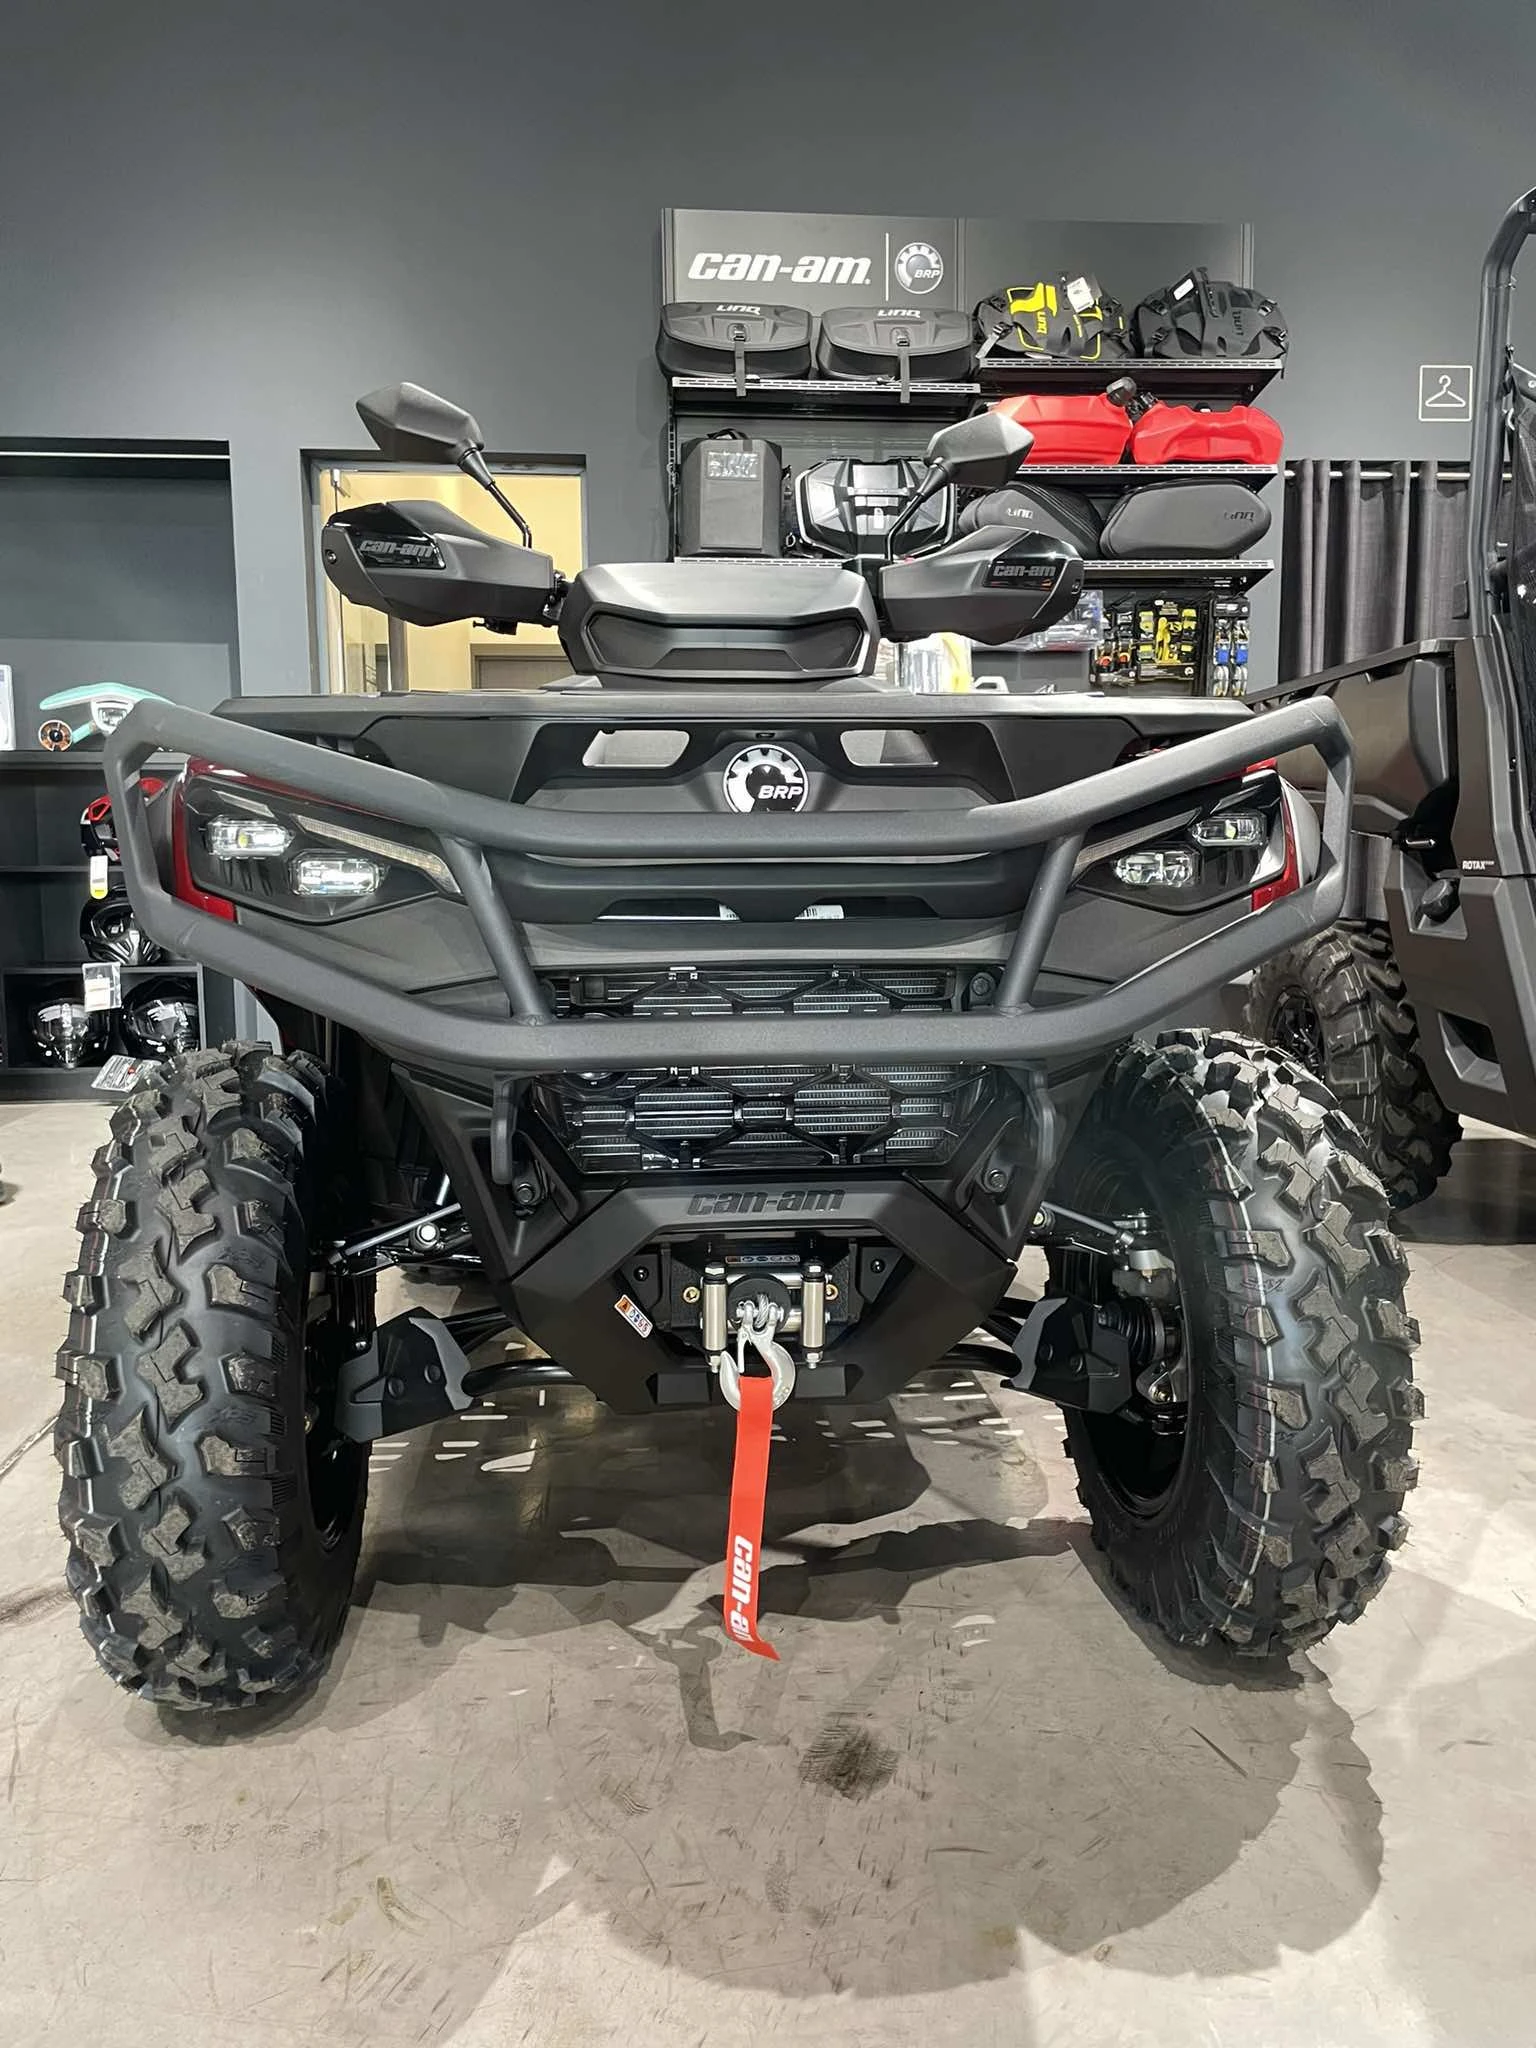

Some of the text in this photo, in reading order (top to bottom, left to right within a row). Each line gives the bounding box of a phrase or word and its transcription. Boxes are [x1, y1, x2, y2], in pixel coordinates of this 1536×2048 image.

[914, 269, 941, 279] BRP
[360, 540, 434, 558] can-am
[993, 565, 1057, 577] can-am
[758, 785, 803, 799] BRP
[687, 1189, 846, 1216] can-am
